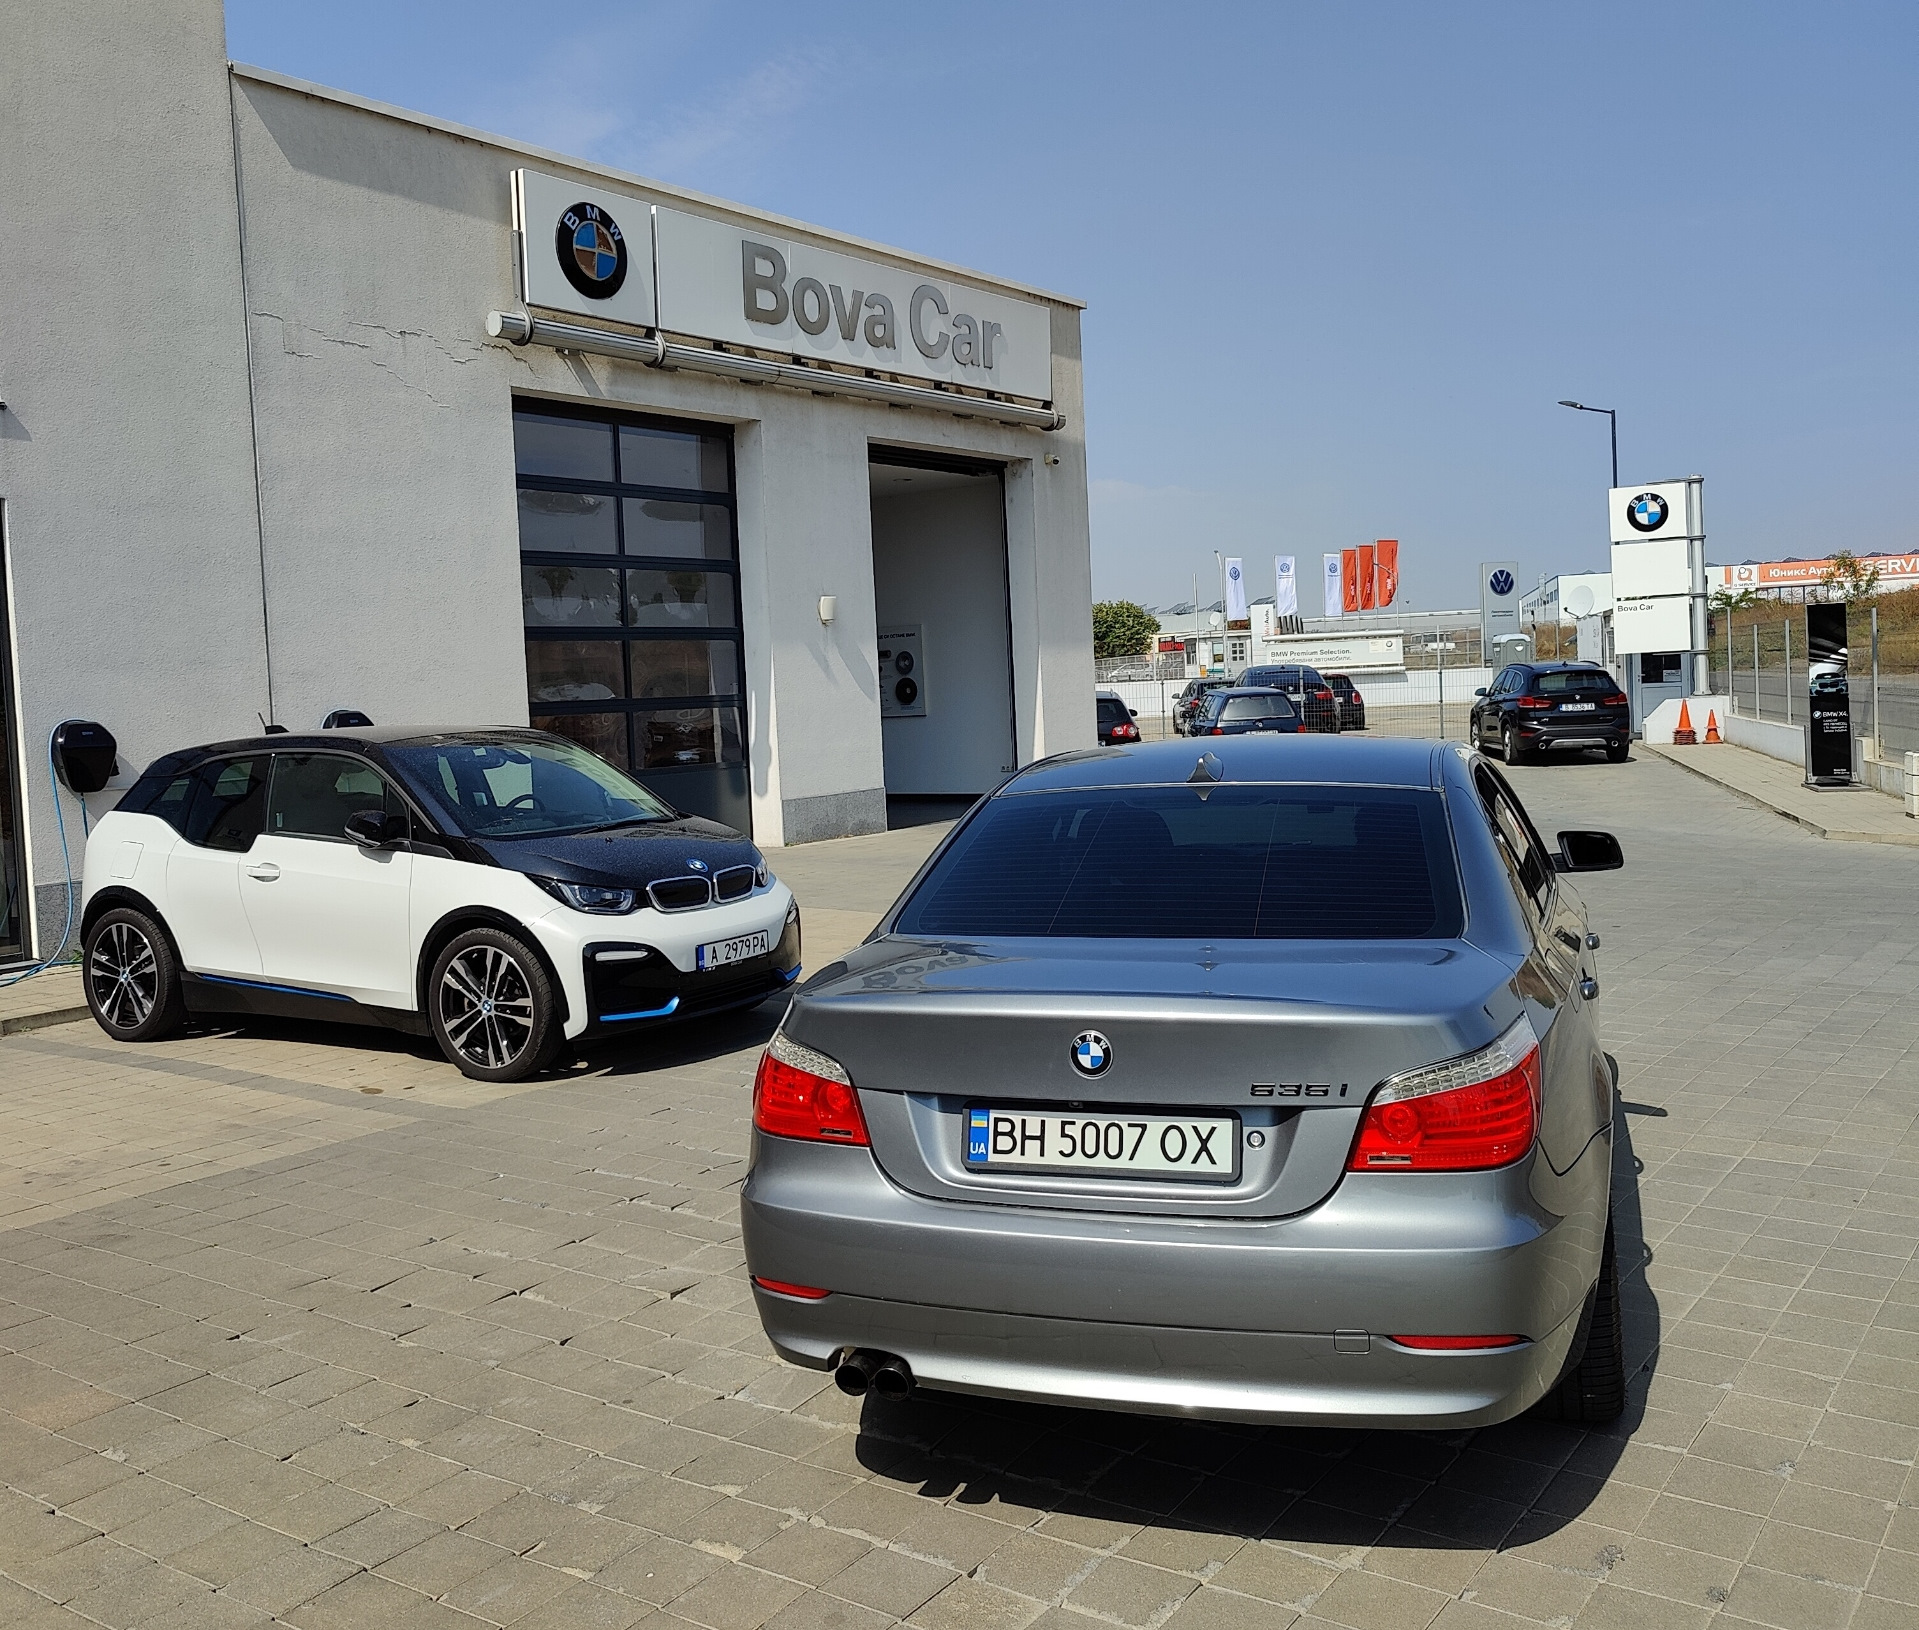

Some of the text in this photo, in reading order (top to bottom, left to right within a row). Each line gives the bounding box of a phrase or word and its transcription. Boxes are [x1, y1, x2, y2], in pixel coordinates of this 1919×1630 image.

[742, 239, 1001, 370] Bova Car
[1769, 567, 1806, 578] Юникс
[1617, 603, 1655, 613] Bova Car
[710, 933, 766, 964] A 2979 PA
[969, 1142, 987, 1155] UA
[992, 1117, 1218, 1166] BH 5007 OX
